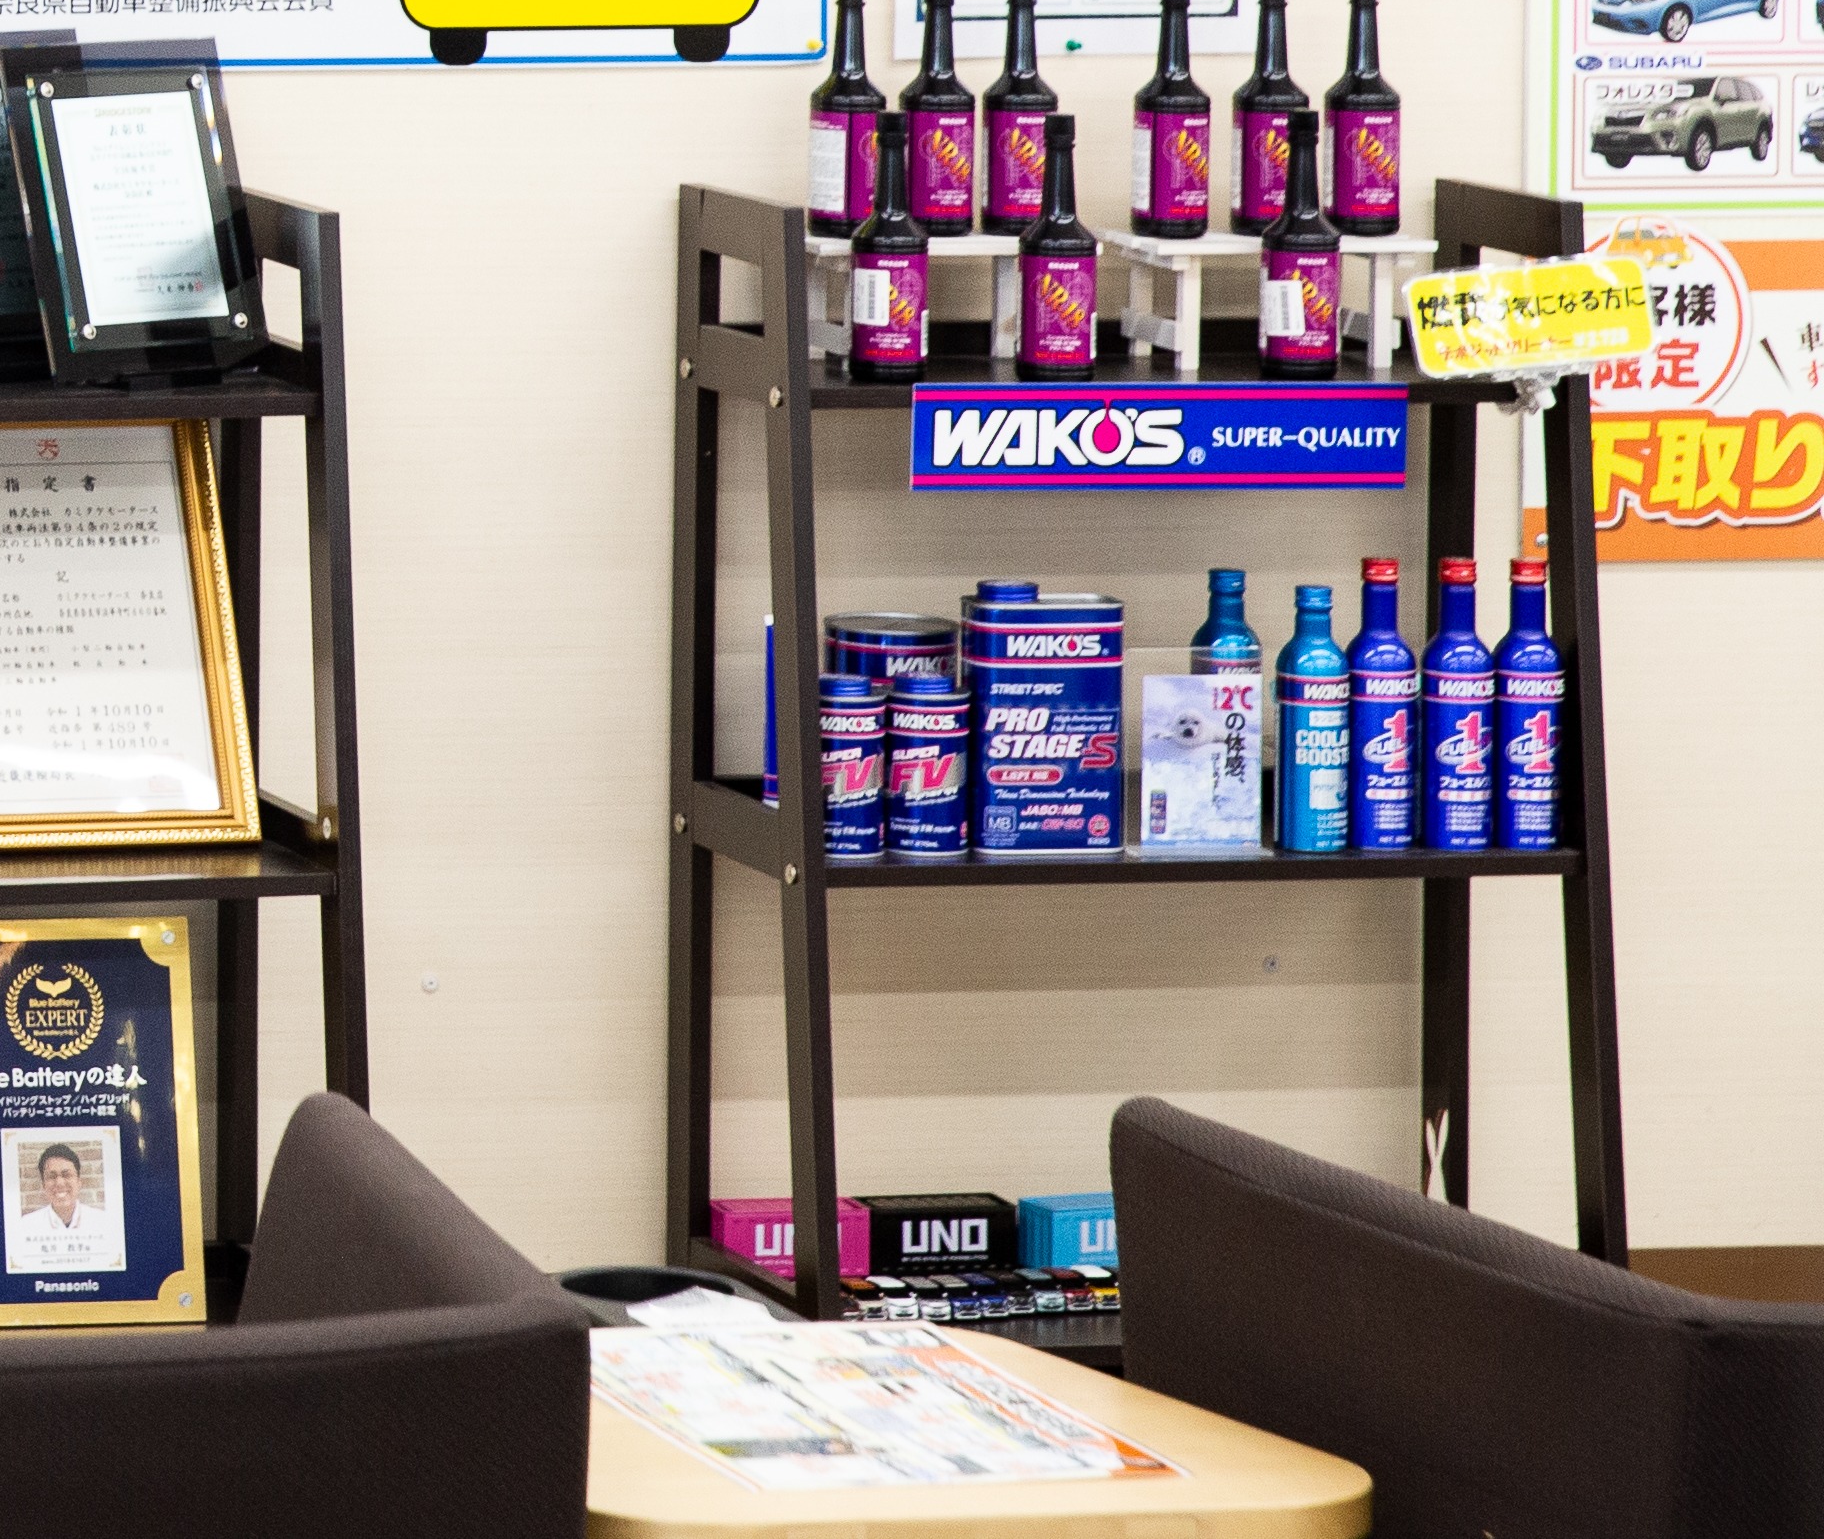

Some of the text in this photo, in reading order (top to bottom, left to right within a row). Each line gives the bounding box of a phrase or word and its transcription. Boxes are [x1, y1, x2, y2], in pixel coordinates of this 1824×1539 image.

[1609, 55, 1702, 70] SUBARU
[932, 408, 1400, 466] WAKO'S SUPER-QUALITY
[985, 707, 1050, 732] PRO
[893, 746, 939, 760] SUPER
[988, 734, 1085, 758] STAGE
[890, 753, 956, 793] FV
[25, 1009, 87, 1028] EXPERT
[902, 1218, 988, 1254] UNO
[34, 1279, 99, 1294] Panasonic
